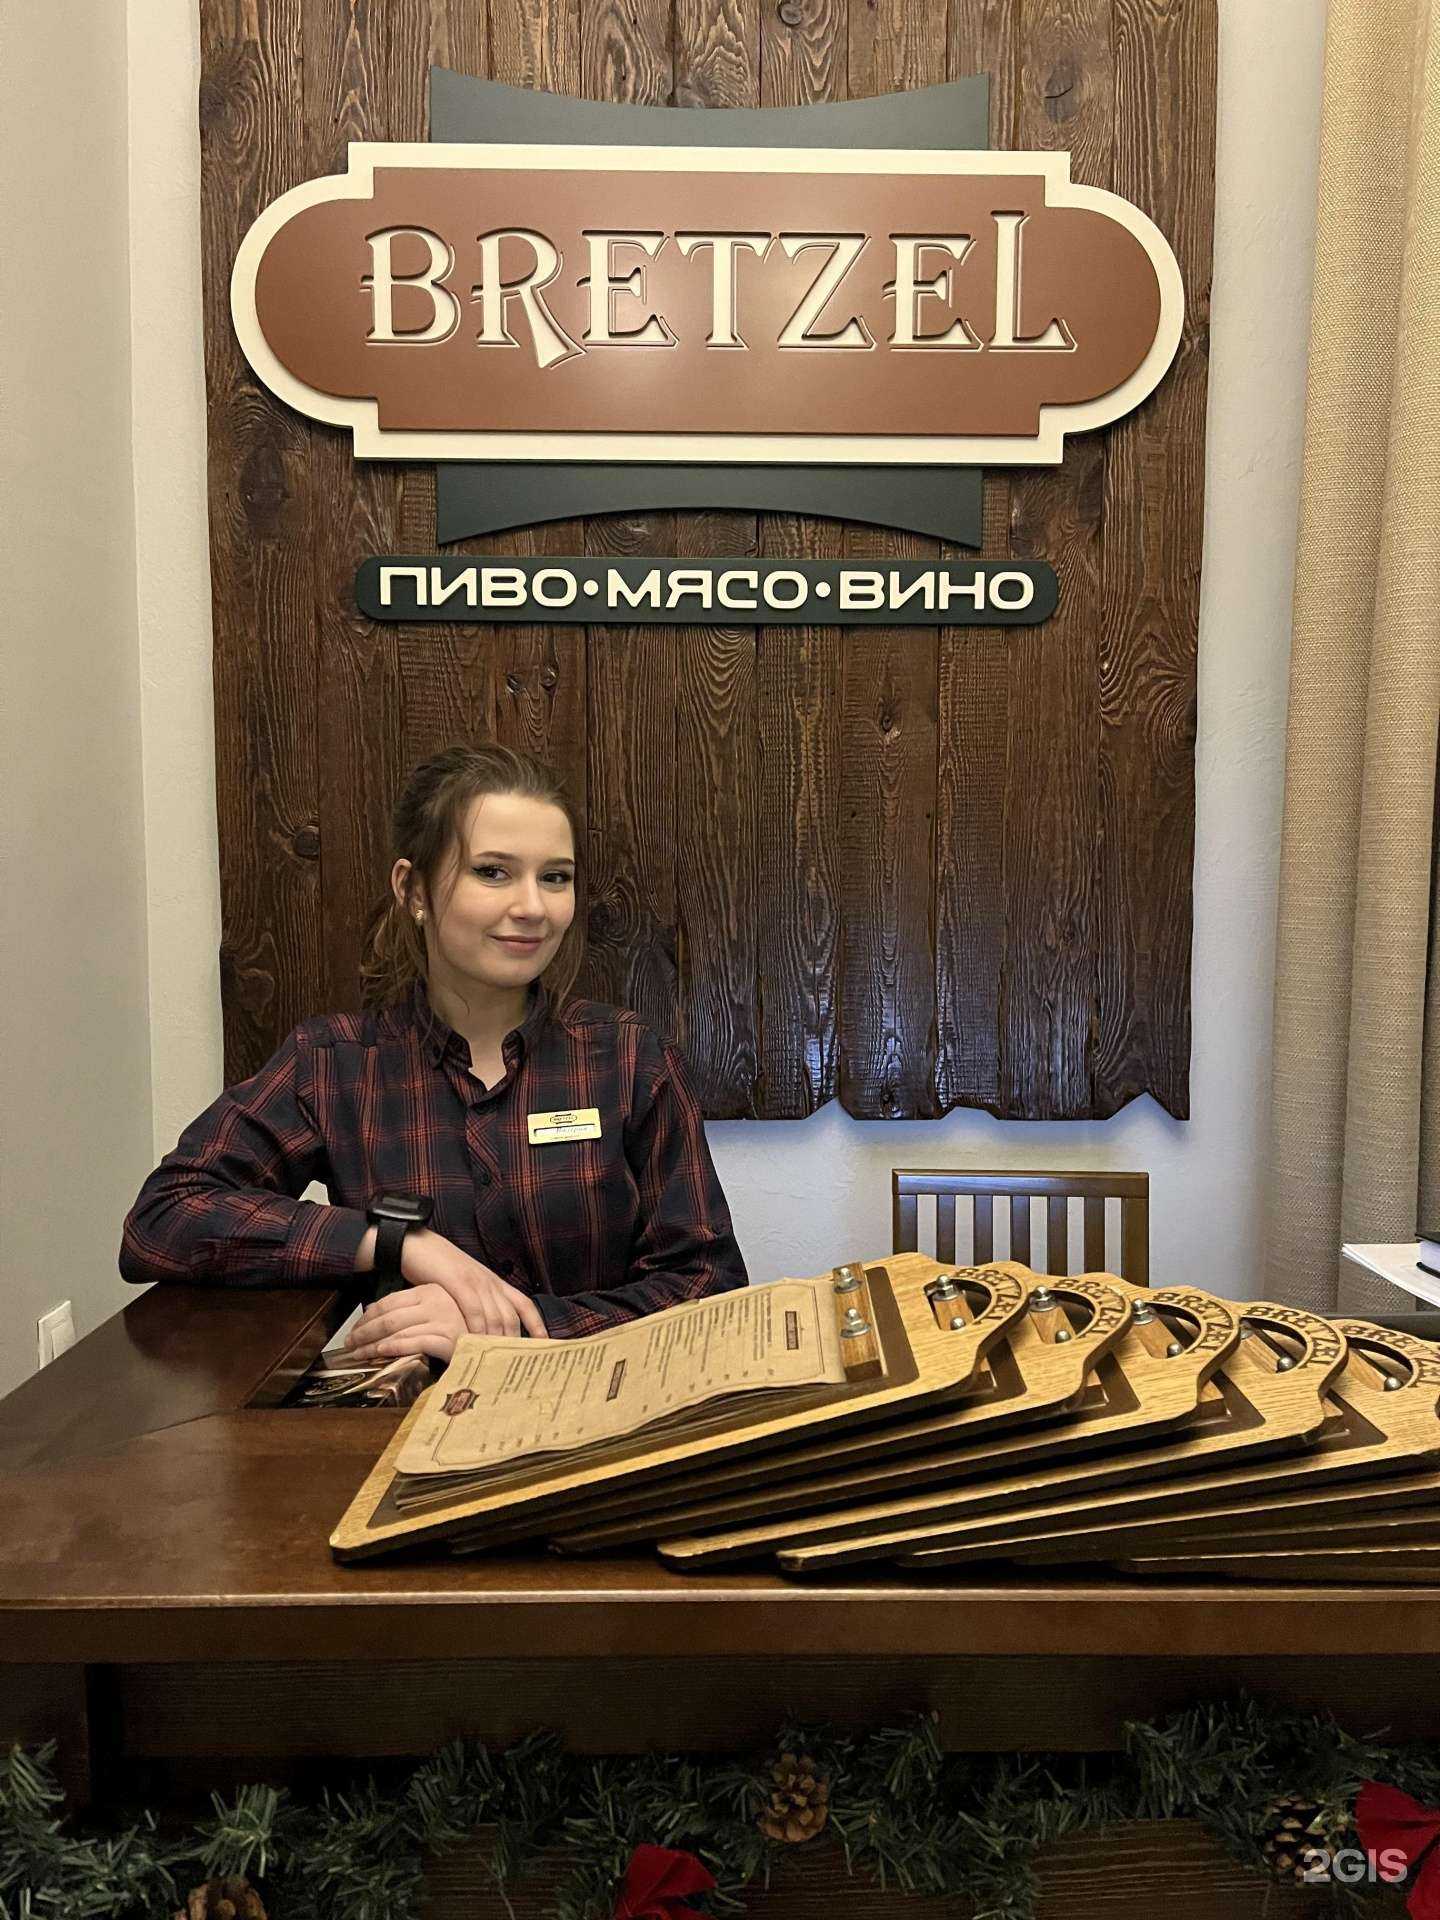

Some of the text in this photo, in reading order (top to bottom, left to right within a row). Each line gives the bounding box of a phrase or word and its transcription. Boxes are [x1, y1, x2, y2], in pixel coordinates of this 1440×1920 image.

[360, 209, 1078, 370] BRETZEL
[380, 567, 1035, 611] ПИВО МЯСО ВИНО
